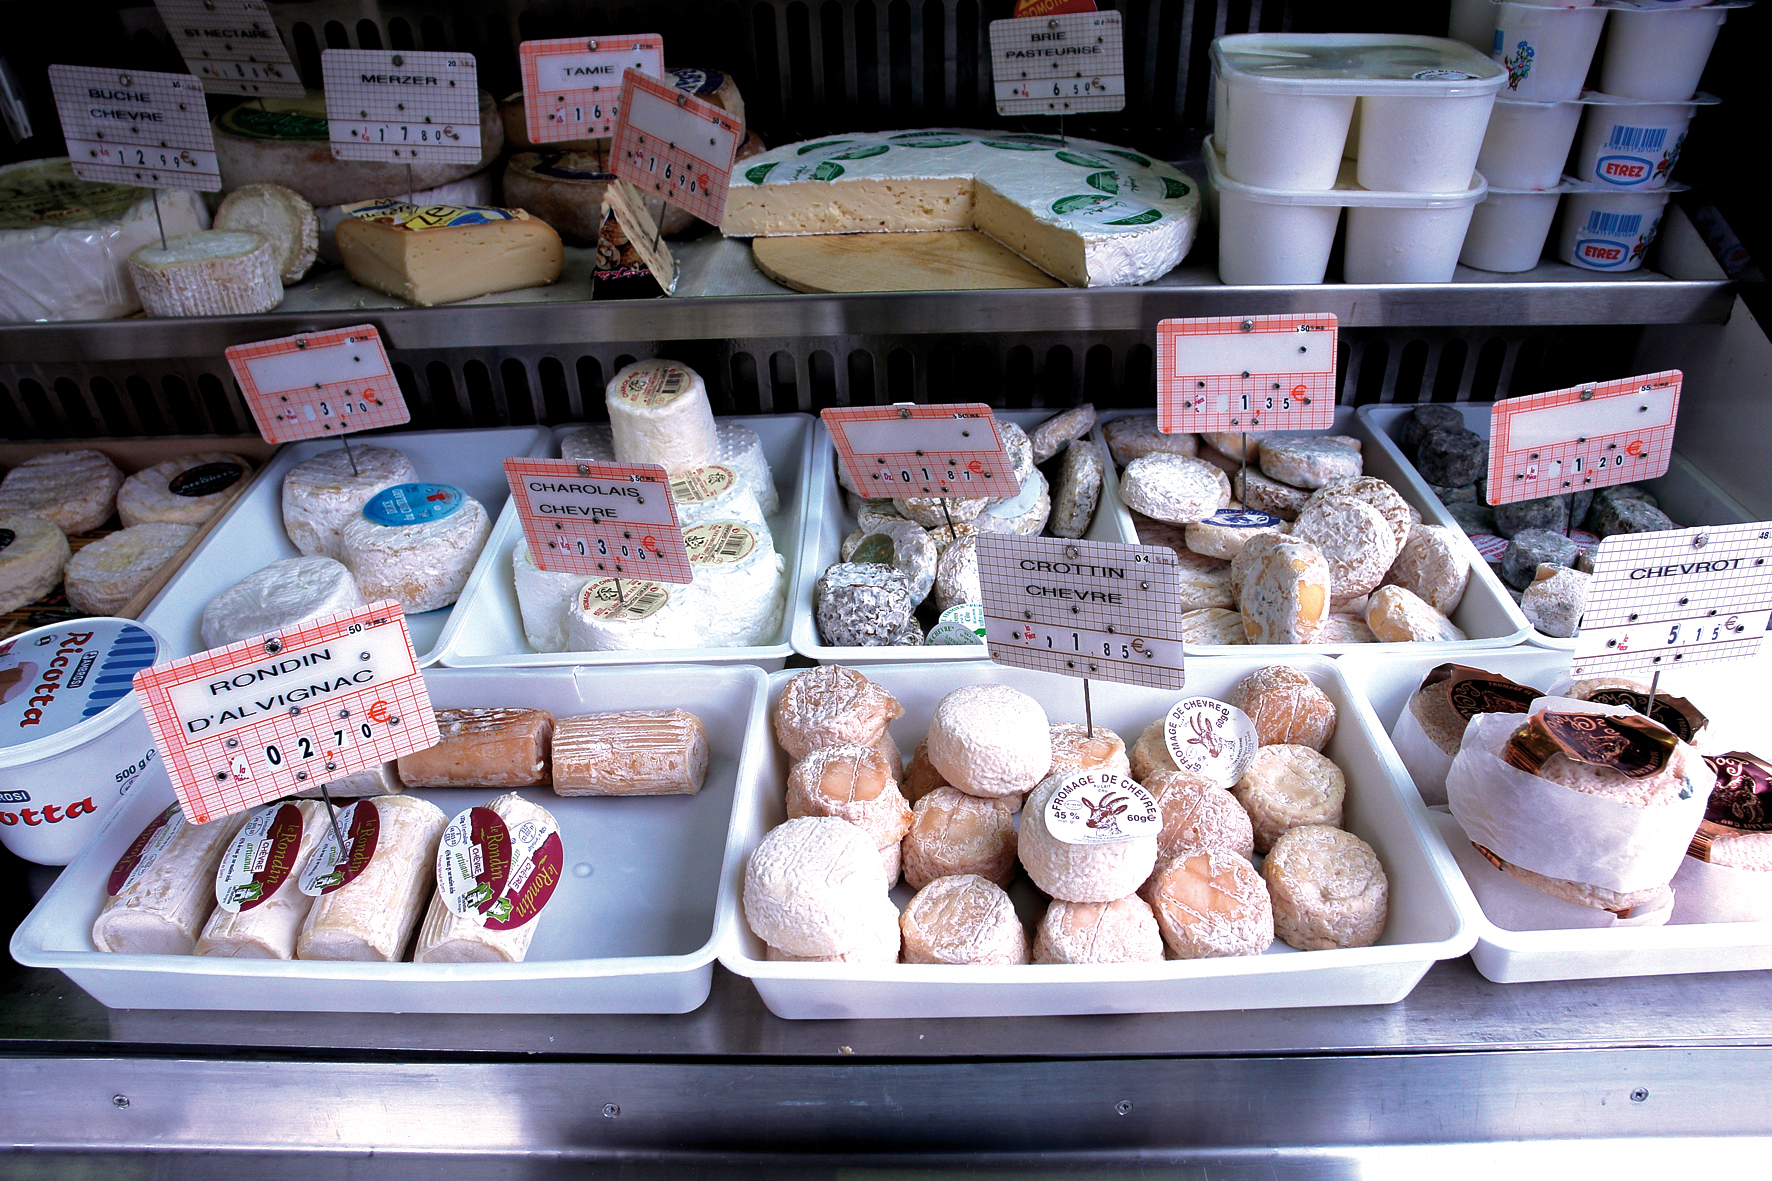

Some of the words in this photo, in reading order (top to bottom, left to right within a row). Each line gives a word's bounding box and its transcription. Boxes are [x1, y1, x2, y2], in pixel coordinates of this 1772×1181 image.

[203, 28, 272, 39] NECTAIRE
[1031, 31, 1067, 42] BRIE
[1006, 45, 1102, 59] PASTEURISE
[563, 65, 615, 76] TAMIE
[361, 74, 438, 86] MERZER
[88, 88, 151, 103] BUCHE
[90, 108, 164, 122] CHEVRE
[1606, 162, 1644, 178] ETREZ
[1584, 245, 1621, 260] ETREZ
[529, 482, 640, 498] CHAROLAIS
[539, 504, 618, 518] CHEVRE
[1019, 559, 1125, 579] CROTTIN
[1630, 557, 1746, 580] CHEVROT
[1026, 584, 1123, 605] CHEVRE
[347, 623, 362, 635] 50
[20, 631, 94, 729] Ricotta
[69, 657, 94, 688] AMBROSI
[209, 648, 332, 696] RONDIN
[1488, 681, 1523, 692] FROMAGE
[186, 669, 375, 734] D'ALVIGNAC
[1183, 699, 1222, 712] CHEVRE
[1172, 707, 1185, 719] DE
[1168, 722, 1193, 770] FROMAGE
[115, 765, 137, 783] 500
[1052, 774, 1095, 811] FROMAGE
[1101, 774, 1118, 785] DE
[1120, 779, 1157, 815] CHEVRE
[366, 818, 377, 828] le
[1053, 811, 1067, 819] 45
[1069, 811, 1080, 820] %
[290, 824, 300, 834] le
[490, 824, 503, 833] le
[121, 817, 161, 866] Rondin
[354, 825, 376, 873] Rondin
[242, 842, 254, 873] artisanal
[267, 832, 297, 884] Rondin
[471, 847, 483, 875] CHÈVRE
[487, 832, 509, 881] Rondin
[455, 851, 471, 880] artisanal
[549, 863, 559, 875] le
[513, 862, 532, 890] CHÈVRE
[516, 871, 554, 917] Rondin
